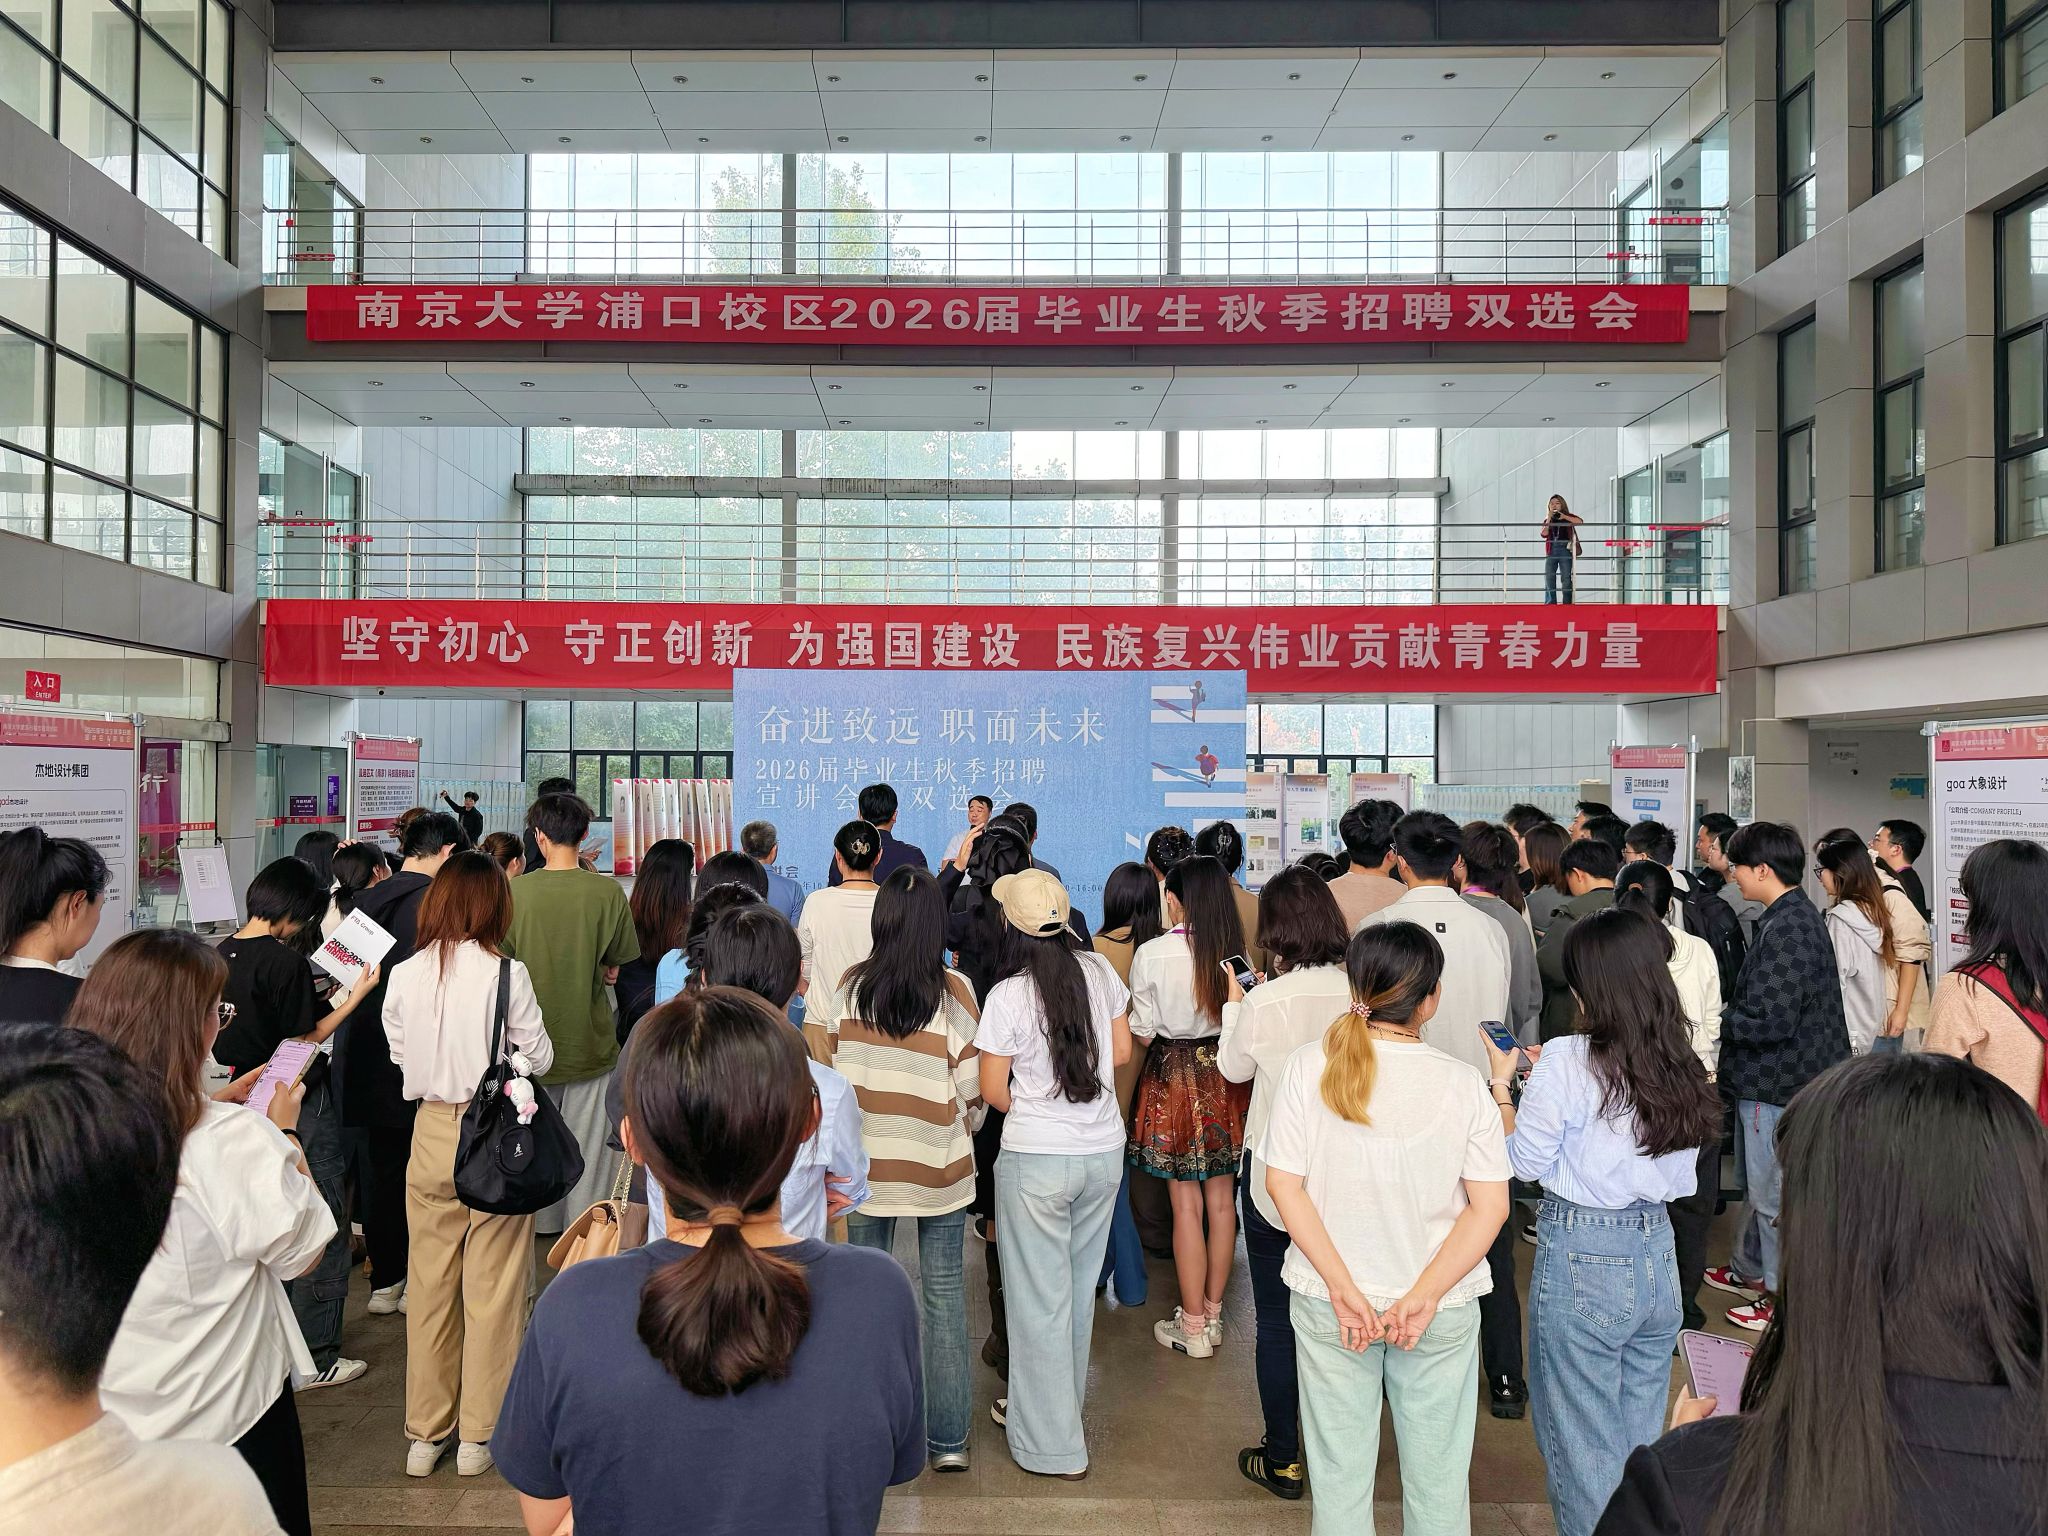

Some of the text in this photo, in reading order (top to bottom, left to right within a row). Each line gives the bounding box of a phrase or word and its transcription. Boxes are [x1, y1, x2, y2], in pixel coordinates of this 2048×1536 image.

[355, 290, 1639, 333] 南京大学浦口校区2026届毕业生秋季招聘双选会
[341, 615, 1644, 670] 坚守初心 守正创新 为强国建设 民族复兴伟业贡献青春力量
[33, 674, 55, 689] 入口
[35, 691, 52, 699] ENTER
[754, 704, 1105, 747] 奋进致远 职面未来
[35, 763, 89, 778] 杰地设计集团
[755, 757, 1048, 785] 2026届毕业生秋季招聘
[1968, 775, 2008, 790] 大象设计
[332, 937, 365, 968] 2025-2026
